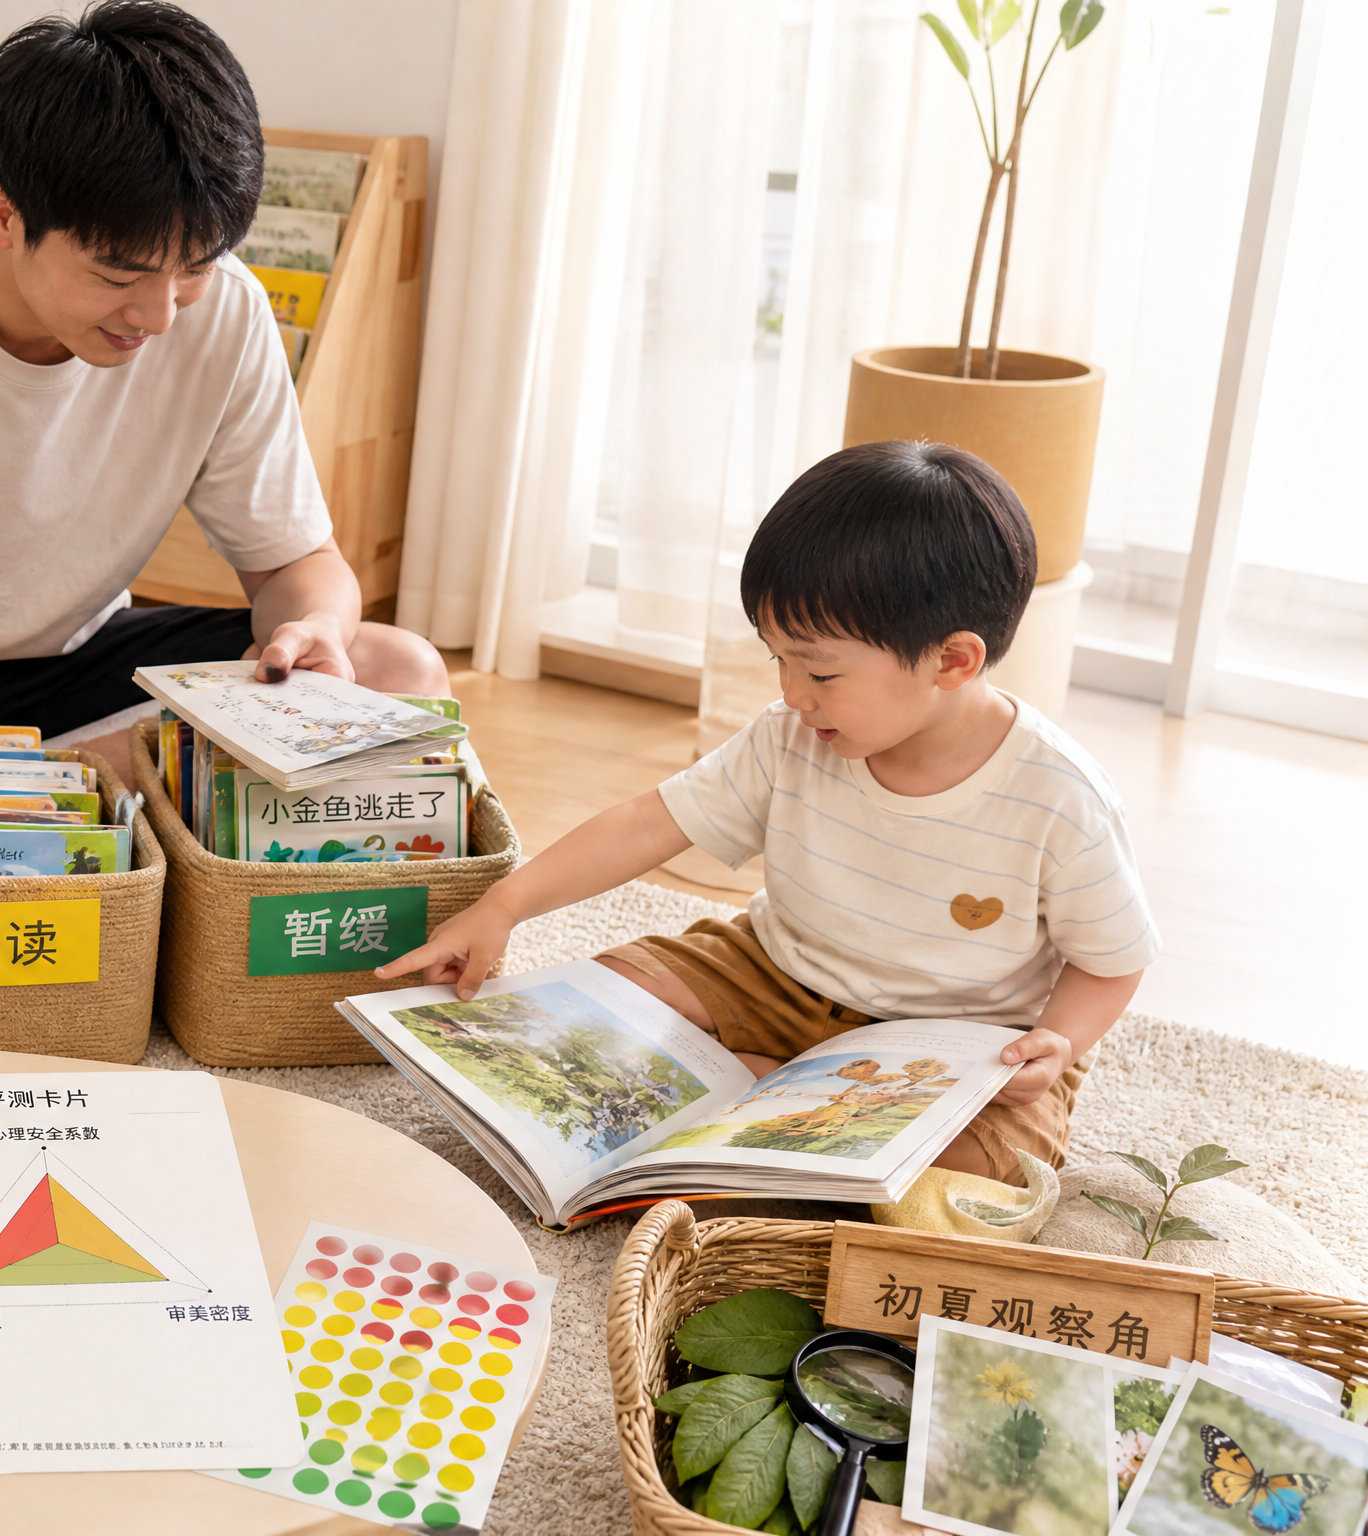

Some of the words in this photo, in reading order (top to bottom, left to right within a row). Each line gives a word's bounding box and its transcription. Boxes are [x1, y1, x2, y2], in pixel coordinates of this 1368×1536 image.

[261, 790, 445, 825] 小金鱼逃走了
[283, 904, 390, 958] 暂缓
[165, 1304, 253, 1323] 审美密度
[873, 1273, 1150, 1360] 初夏观察角
